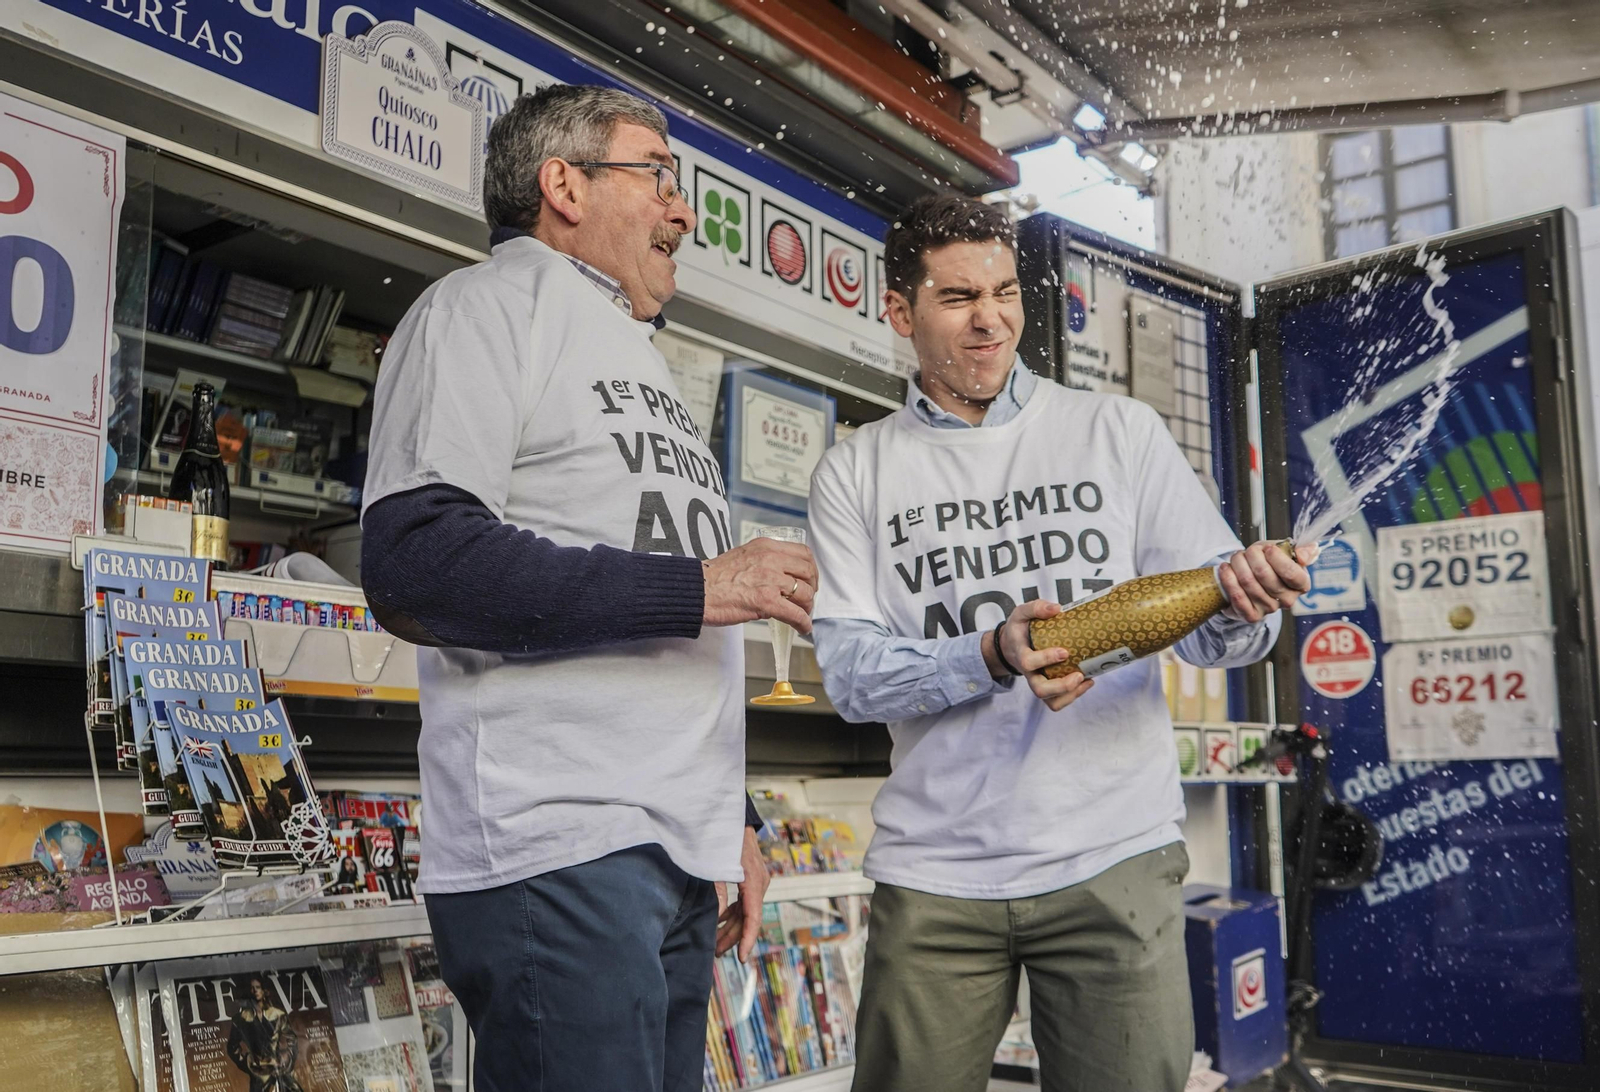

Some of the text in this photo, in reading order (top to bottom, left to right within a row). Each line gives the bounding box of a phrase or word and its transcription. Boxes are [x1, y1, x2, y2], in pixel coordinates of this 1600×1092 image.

[378, 86, 438, 131] Quiosco
[371, 116, 442, 171] CHALO
[0, 469, 46, 489] BRE
[935, 481, 1103, 533] PREMIO
[1421, 529, 1519, 554] PREMIO
[95, 552, 199, 584] GRANADA
[894, 528, 1110, 595] VENDIDO
[1391, 551, 1532, 591] 92052
[113, 598, 211, 629] GRANADA
[129, 641, 237, 666] GRANADA
[1315, 629, 1357, 655] +18
[1441, 644, 1513, 665] PREMIO
[148, 668, 255, 694] GRANADA
[175, 706, 280, 734] GRANADA
[191, 757, 219, 769] ENGLISH
[1374, 758, 1545, 843] uestas del
[256, 843, 286, 851] GUIDE
[374, 848, 394, 868] 66
[84, 877, 148, 898] REGALO
